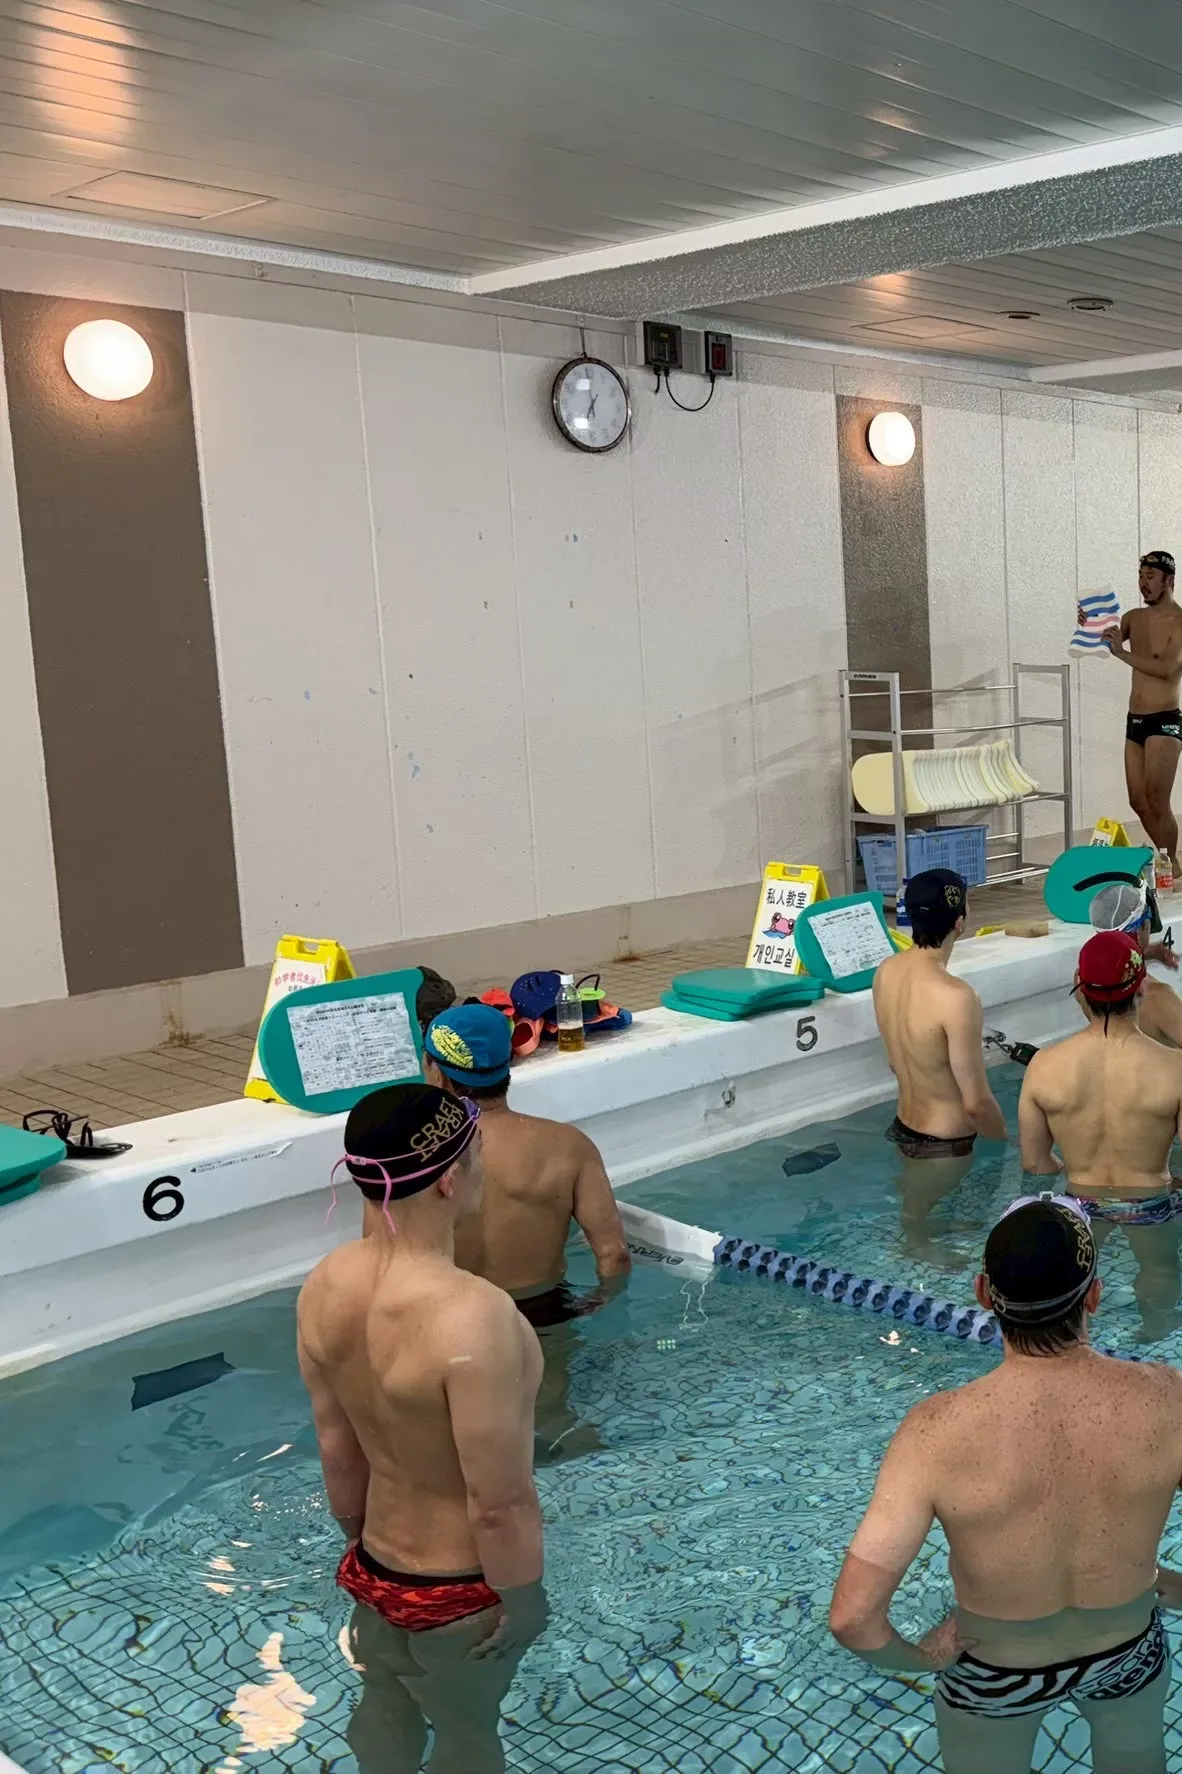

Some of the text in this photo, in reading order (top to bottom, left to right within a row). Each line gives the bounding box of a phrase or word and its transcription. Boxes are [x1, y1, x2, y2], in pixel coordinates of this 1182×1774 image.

[766, 887, 807, 909] 私人教室
[752, 944, 795, 968] 개인교실
[1163, 926, 1174, 951] 4
[796, 1015, 818, 1051] 5
[410, 1097, 454, 1149] CRAFT
[142, 1175, 185, 1222] 6
[1087, 1630, 1164, 1698] arena
